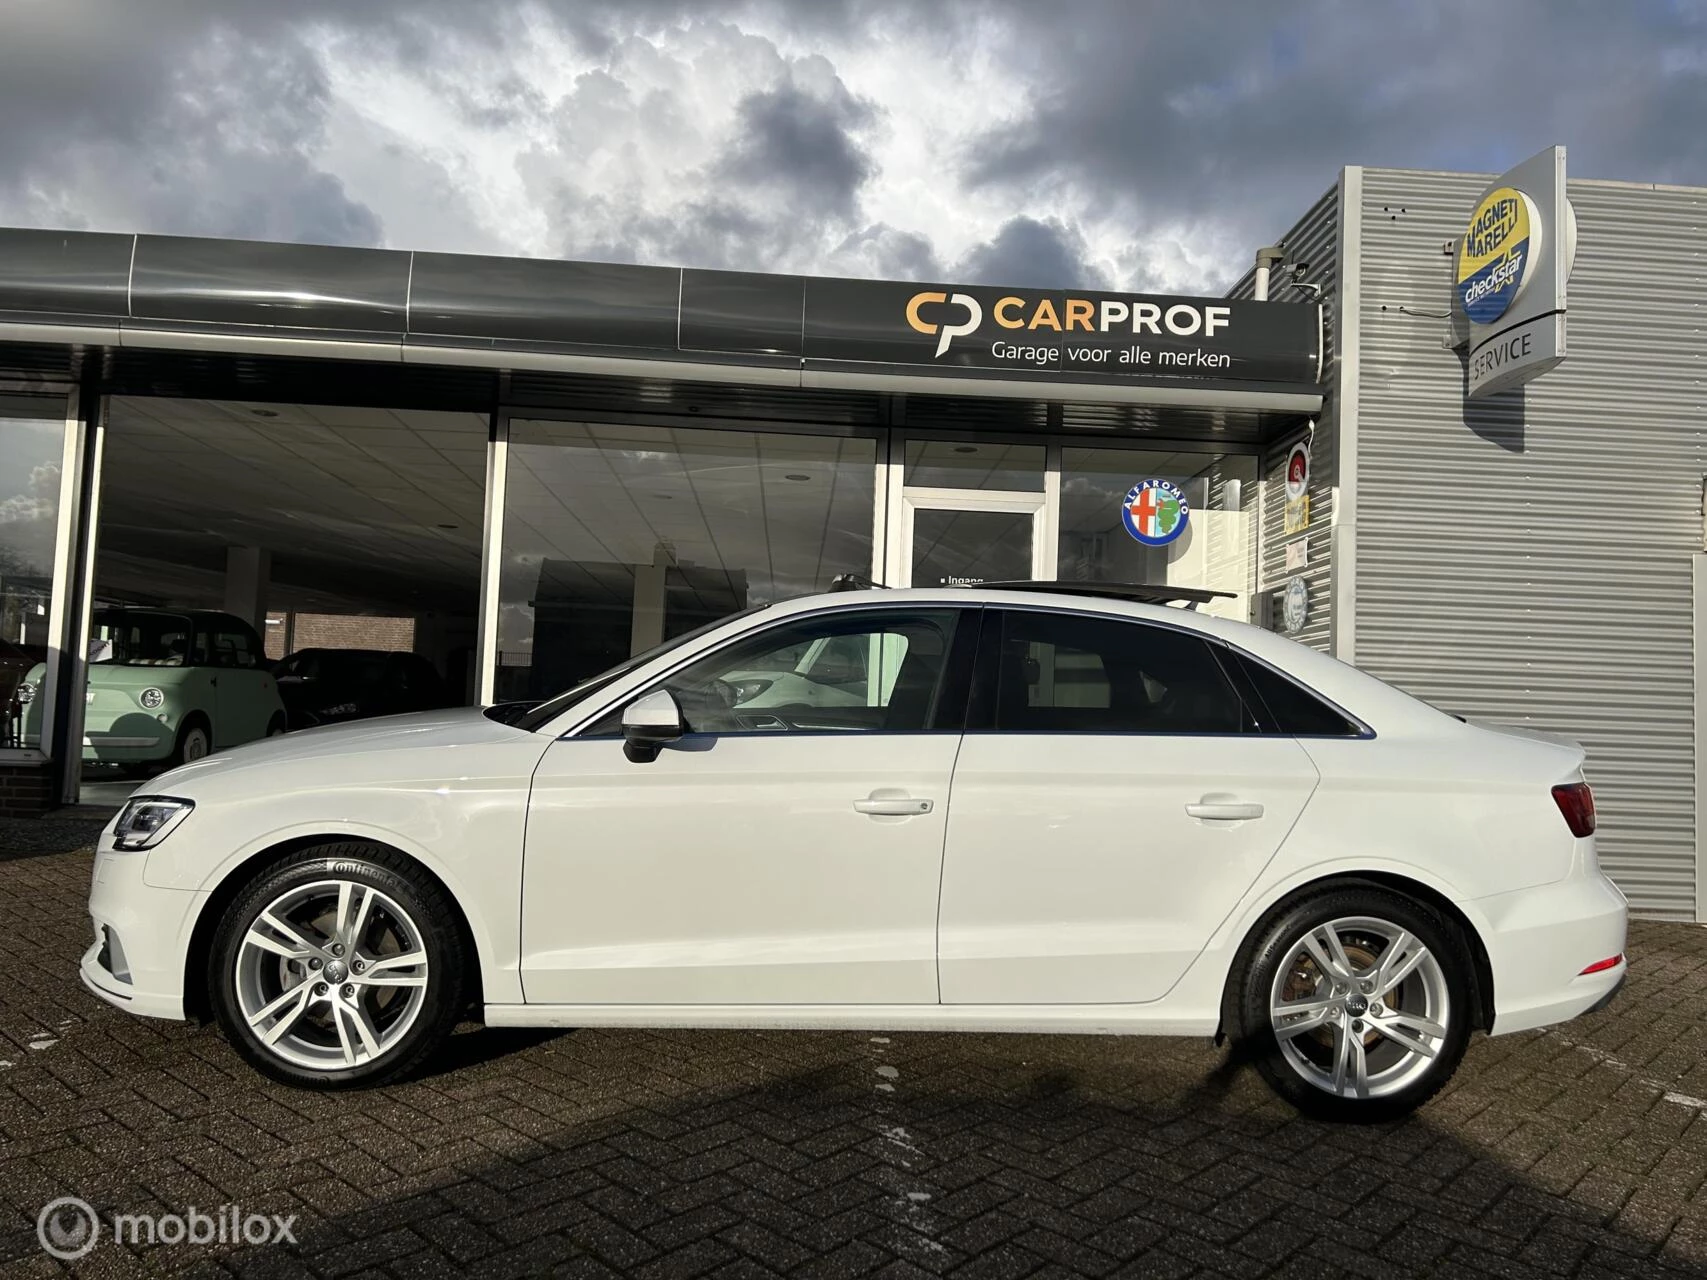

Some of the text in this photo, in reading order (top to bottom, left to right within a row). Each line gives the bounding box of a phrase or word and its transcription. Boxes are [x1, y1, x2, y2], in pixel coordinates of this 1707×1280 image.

[1467, 199, 1518, 248] MAGNETI
[1467, 211, 1518, 258] MARELLI
[1465, 254, 1523, 303] checkstar
[993, 296, 1231, 337] CARPROF
[991, 341, 1231, 368] Garage voor alle merken
[1474, 333, 1532, 381] SERVICE
